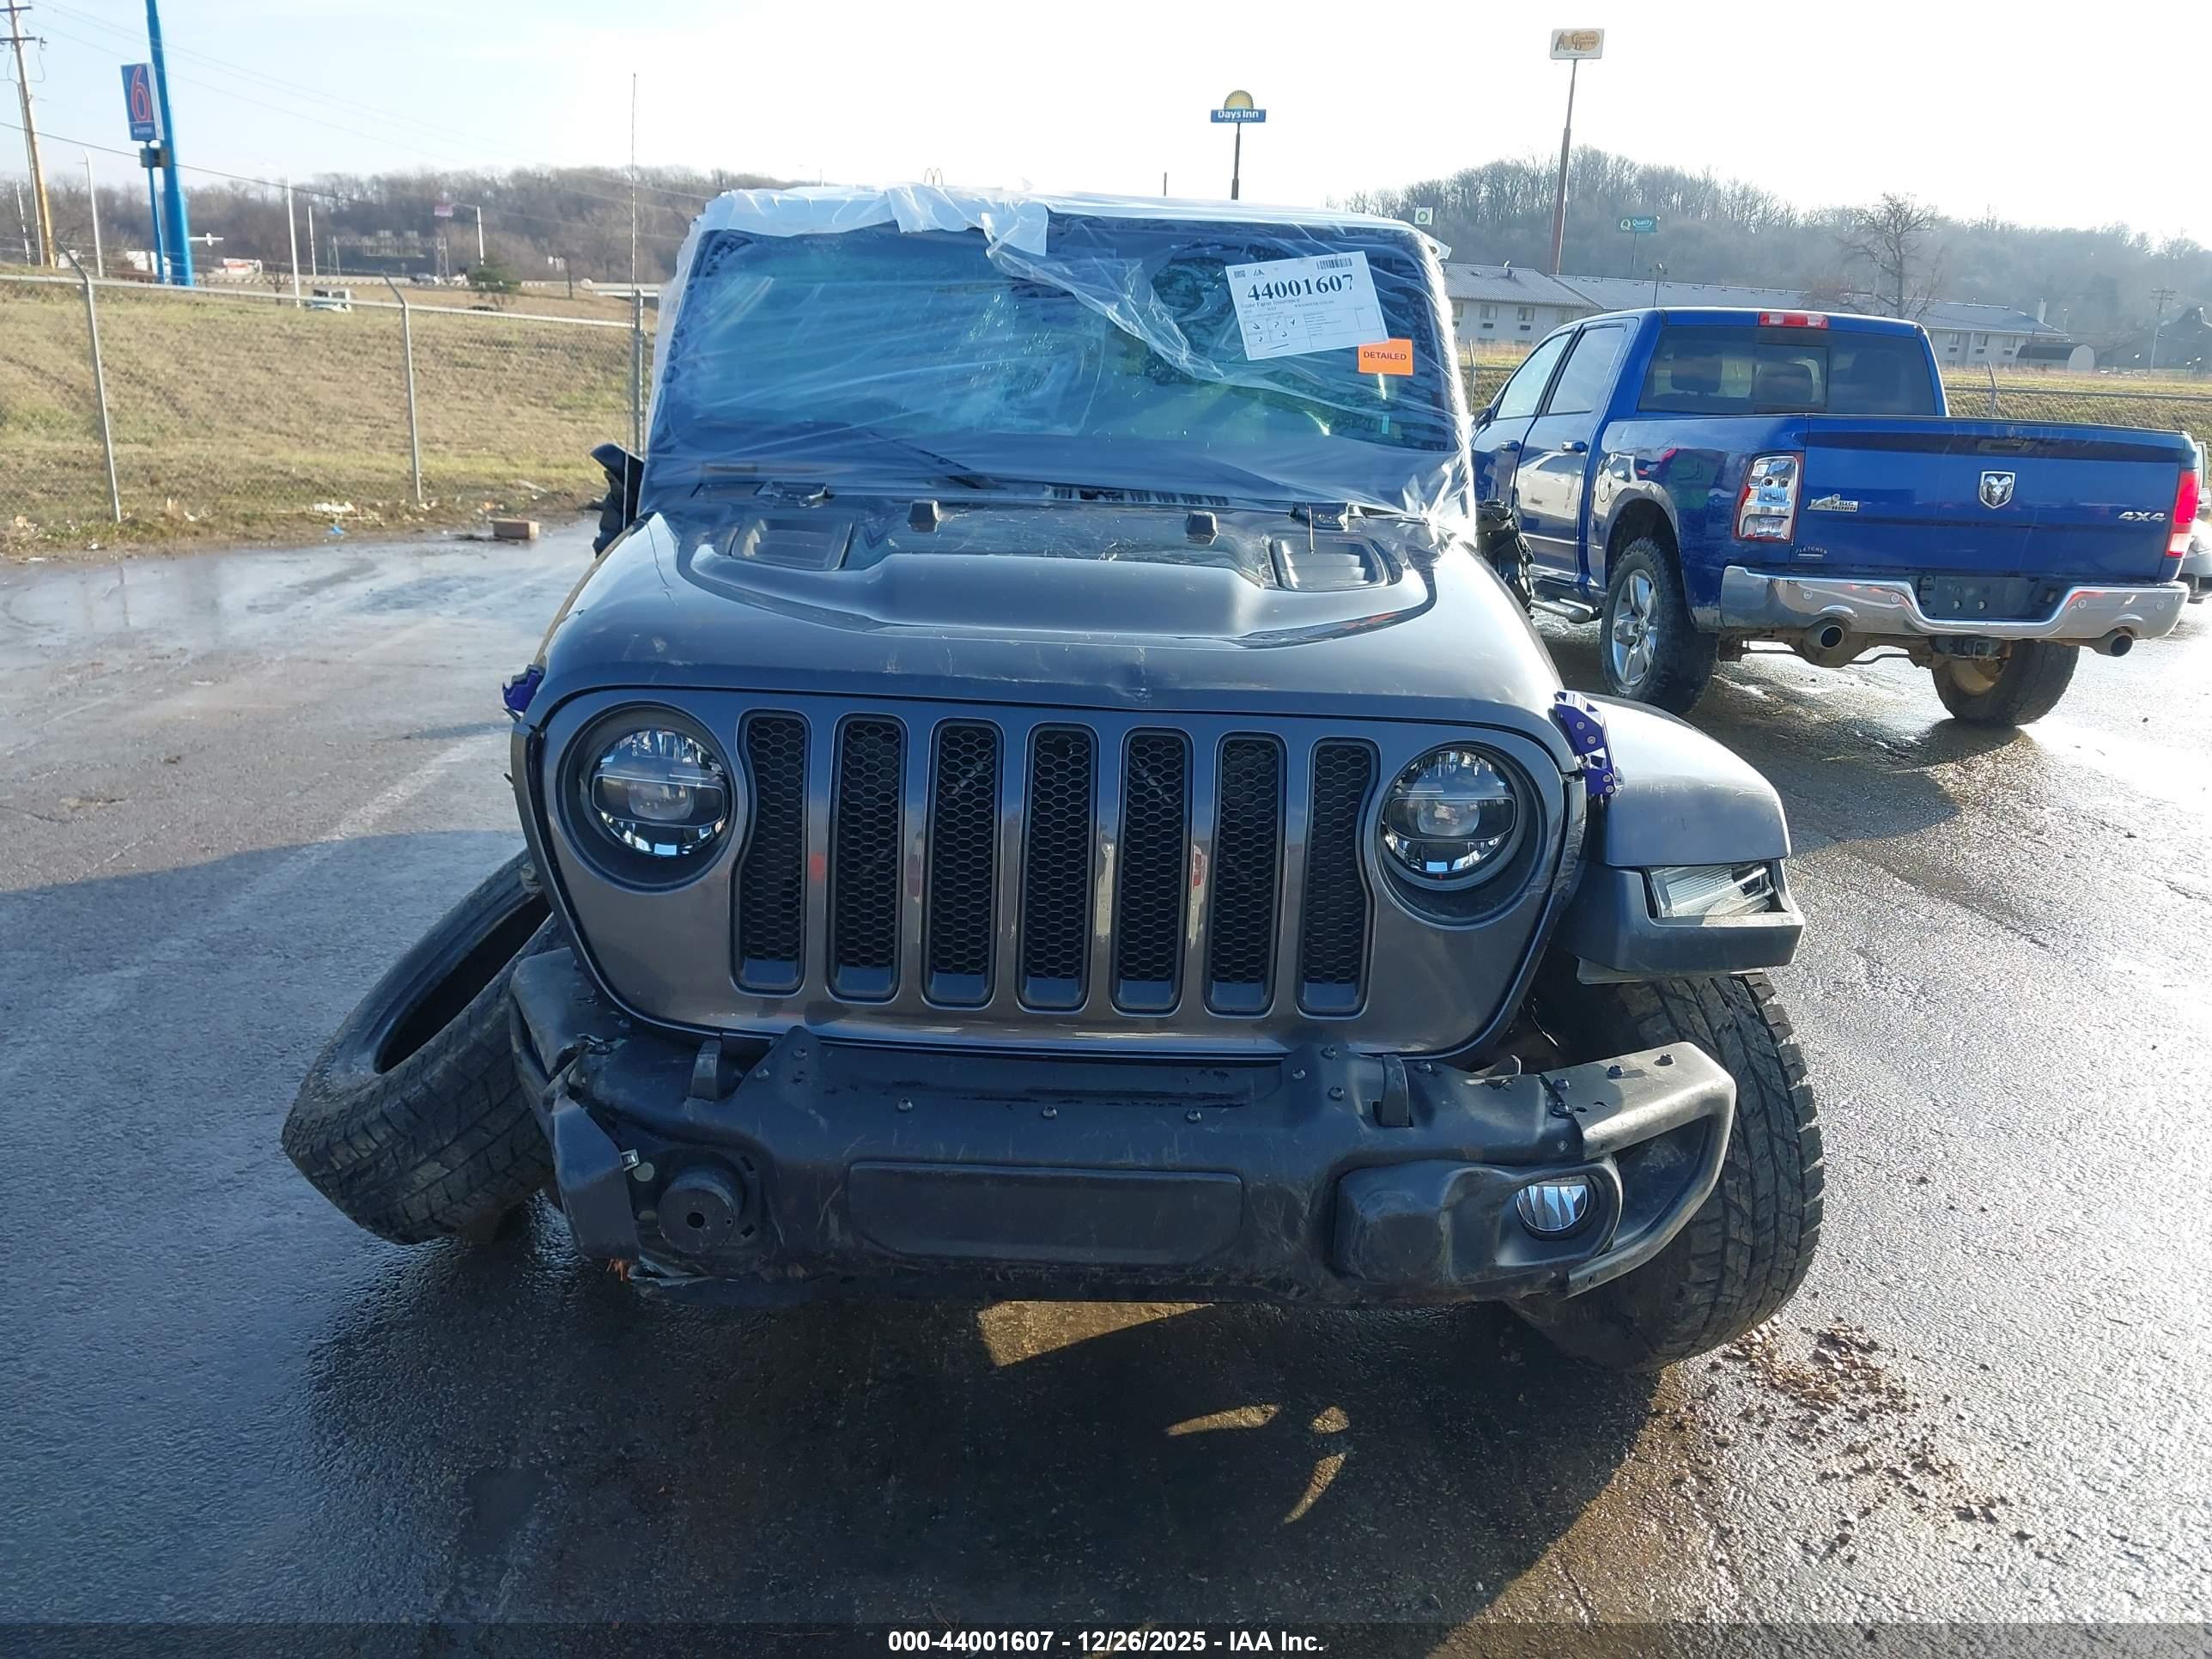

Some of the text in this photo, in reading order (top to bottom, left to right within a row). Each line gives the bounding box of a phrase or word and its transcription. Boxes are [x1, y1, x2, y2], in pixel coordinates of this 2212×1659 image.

[131, 66, 151, 122] 6
[1218, 110, 1242, 118] Days
[1632, 219, 1653, 228] Quality
[1248, 274, 1353, 301] 44001607
[1364, 350, 1407, 361] DETAILED
